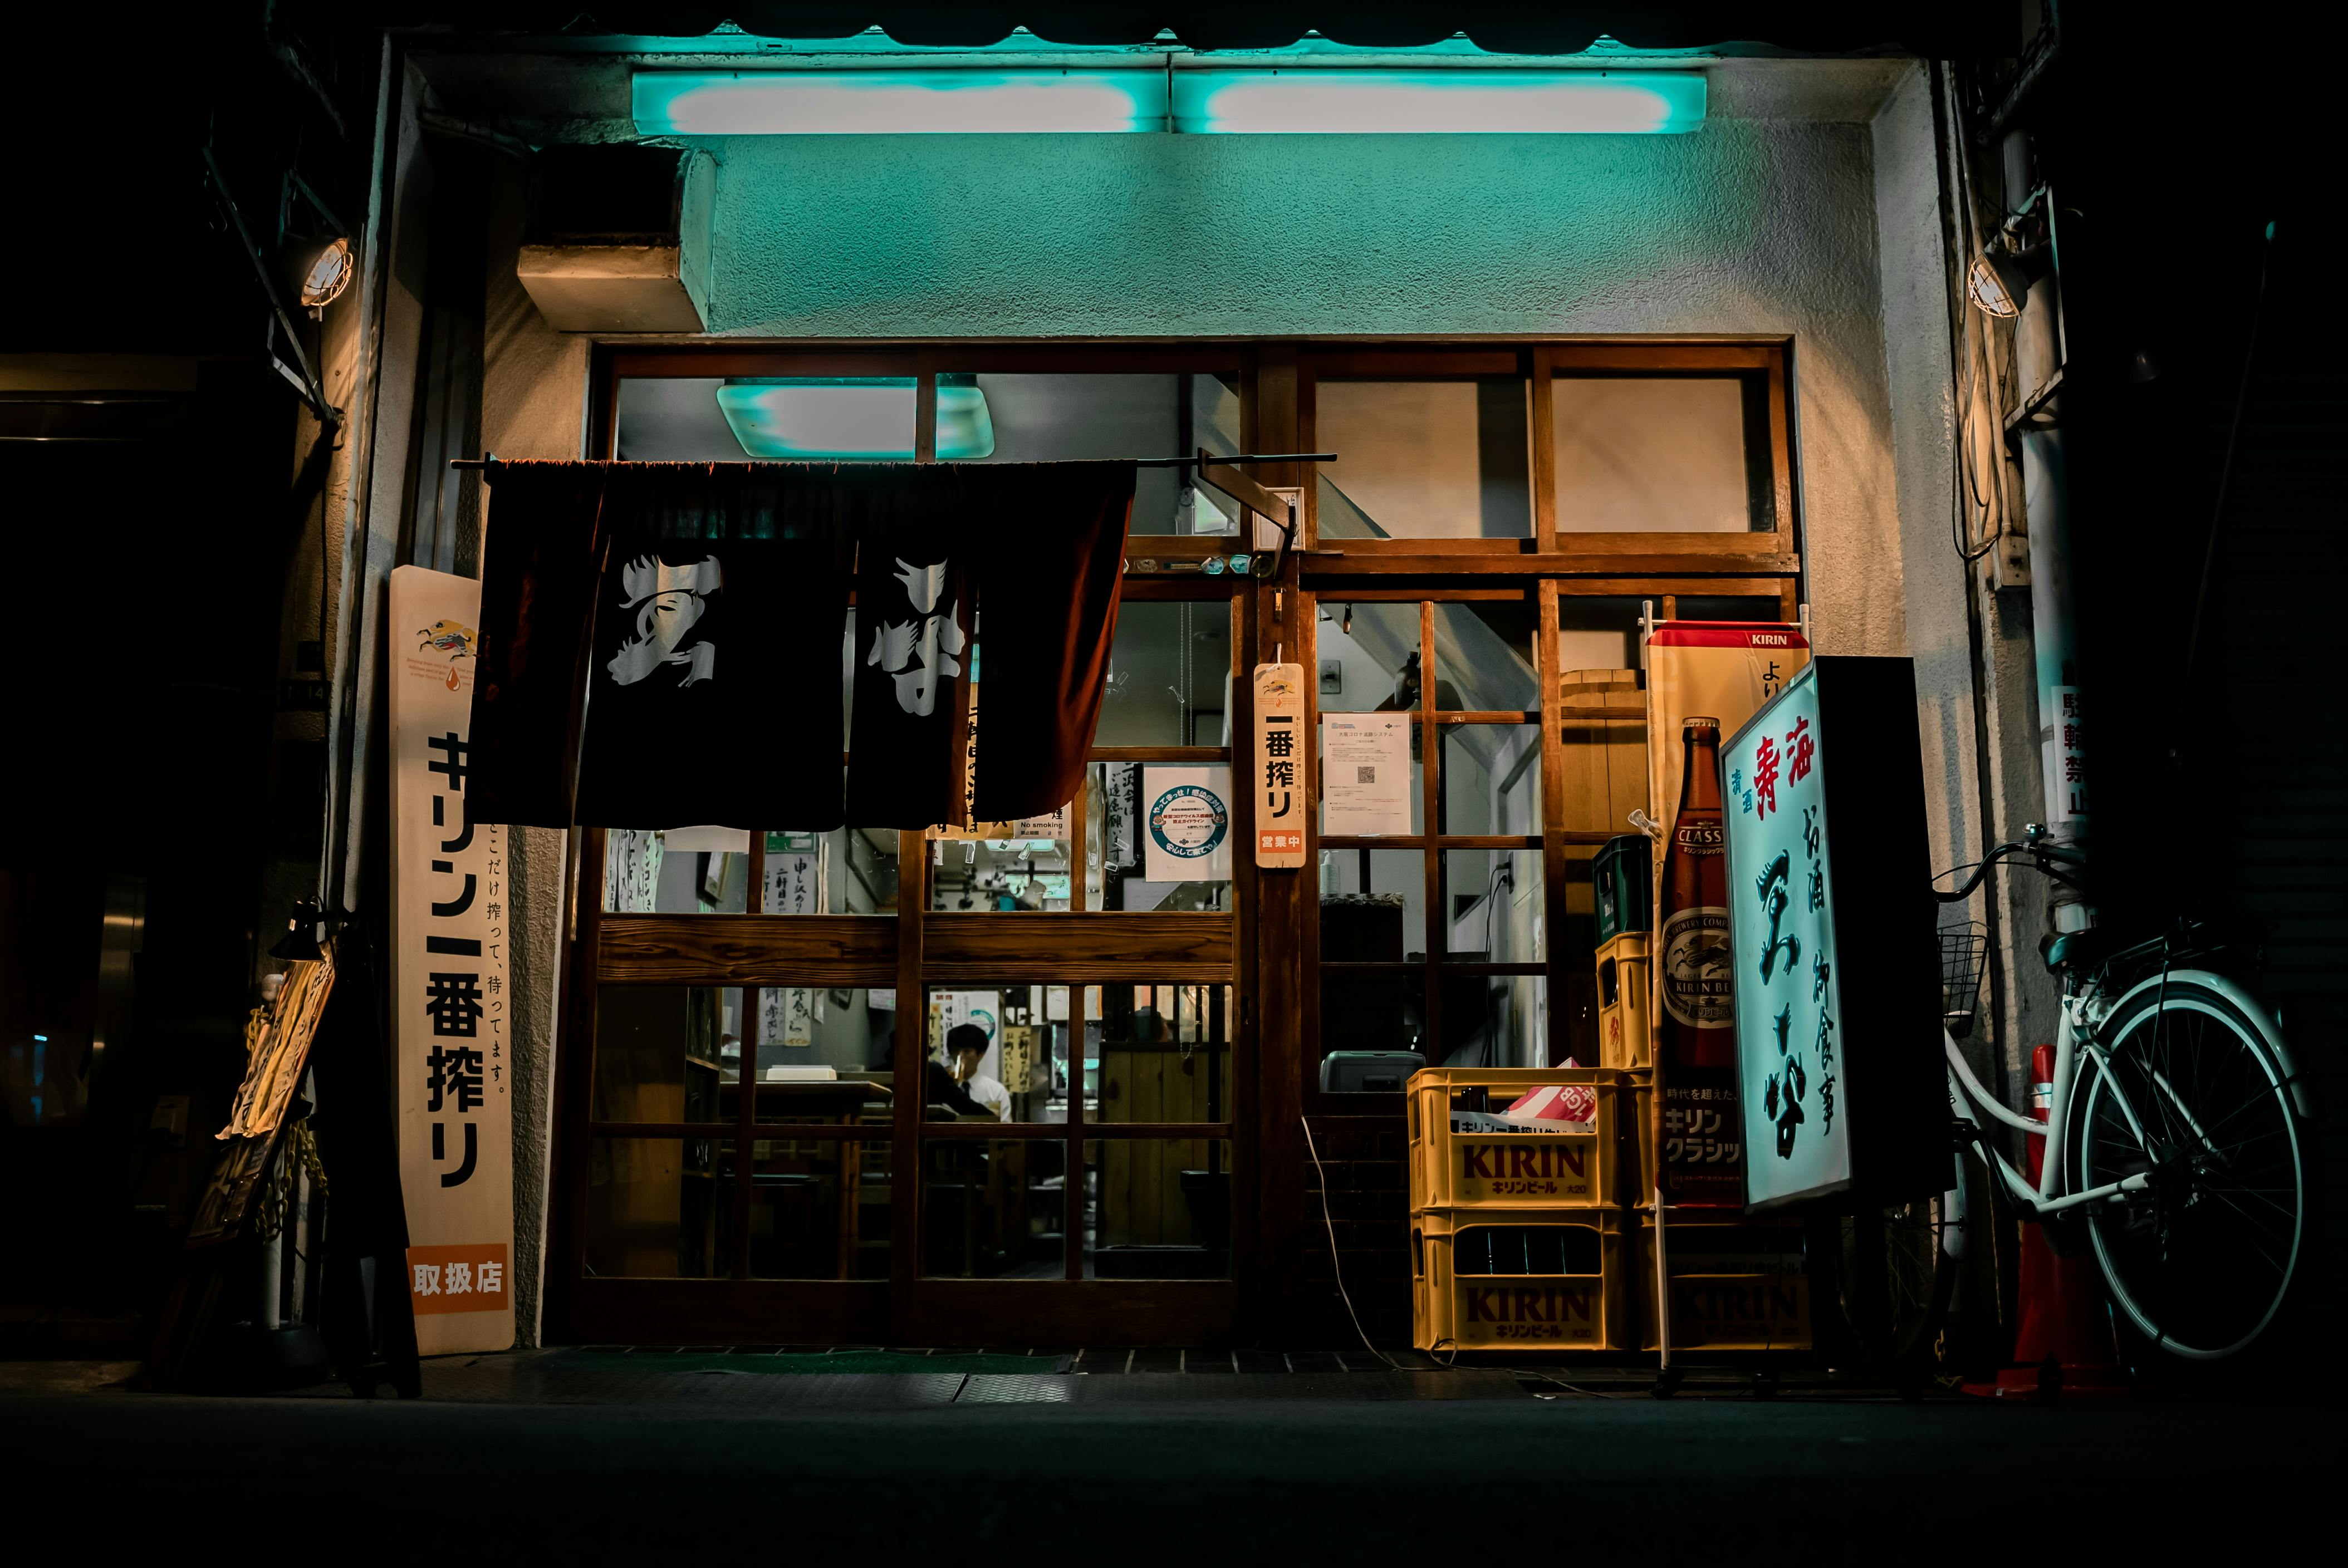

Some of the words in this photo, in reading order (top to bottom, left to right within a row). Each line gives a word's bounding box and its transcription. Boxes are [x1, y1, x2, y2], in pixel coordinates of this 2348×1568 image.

[1752, 635, 1787, 645] KIRIN
[1266, 716, 1293, 818] 一番搾り
[1262, 835, 1300, 848] 営業中
[1704, 917, 1728, 927] COMP
[426, 732, 483, 1188] キリン一番搾り
[1676, 982, 1710, 993] KIRIN
[1668, 1088, 1737, 1100] 時代を超えた、
[1666, 1108, 1721, 1134] キリン
[1463, 1144, 1585, 1178] KIRIN
[1492, 1181, 1557, 1194] キリンビール
[1567, 1185, 1586, 1193] 大20
[414, 1261, 502, 1296] 取扱店
[1467, 1287, 1590, 1322] KIRIN
[1675, 1286, 1798, 1320] KIRIN
[1496, 1324, 1562, 1338] キリンビール
